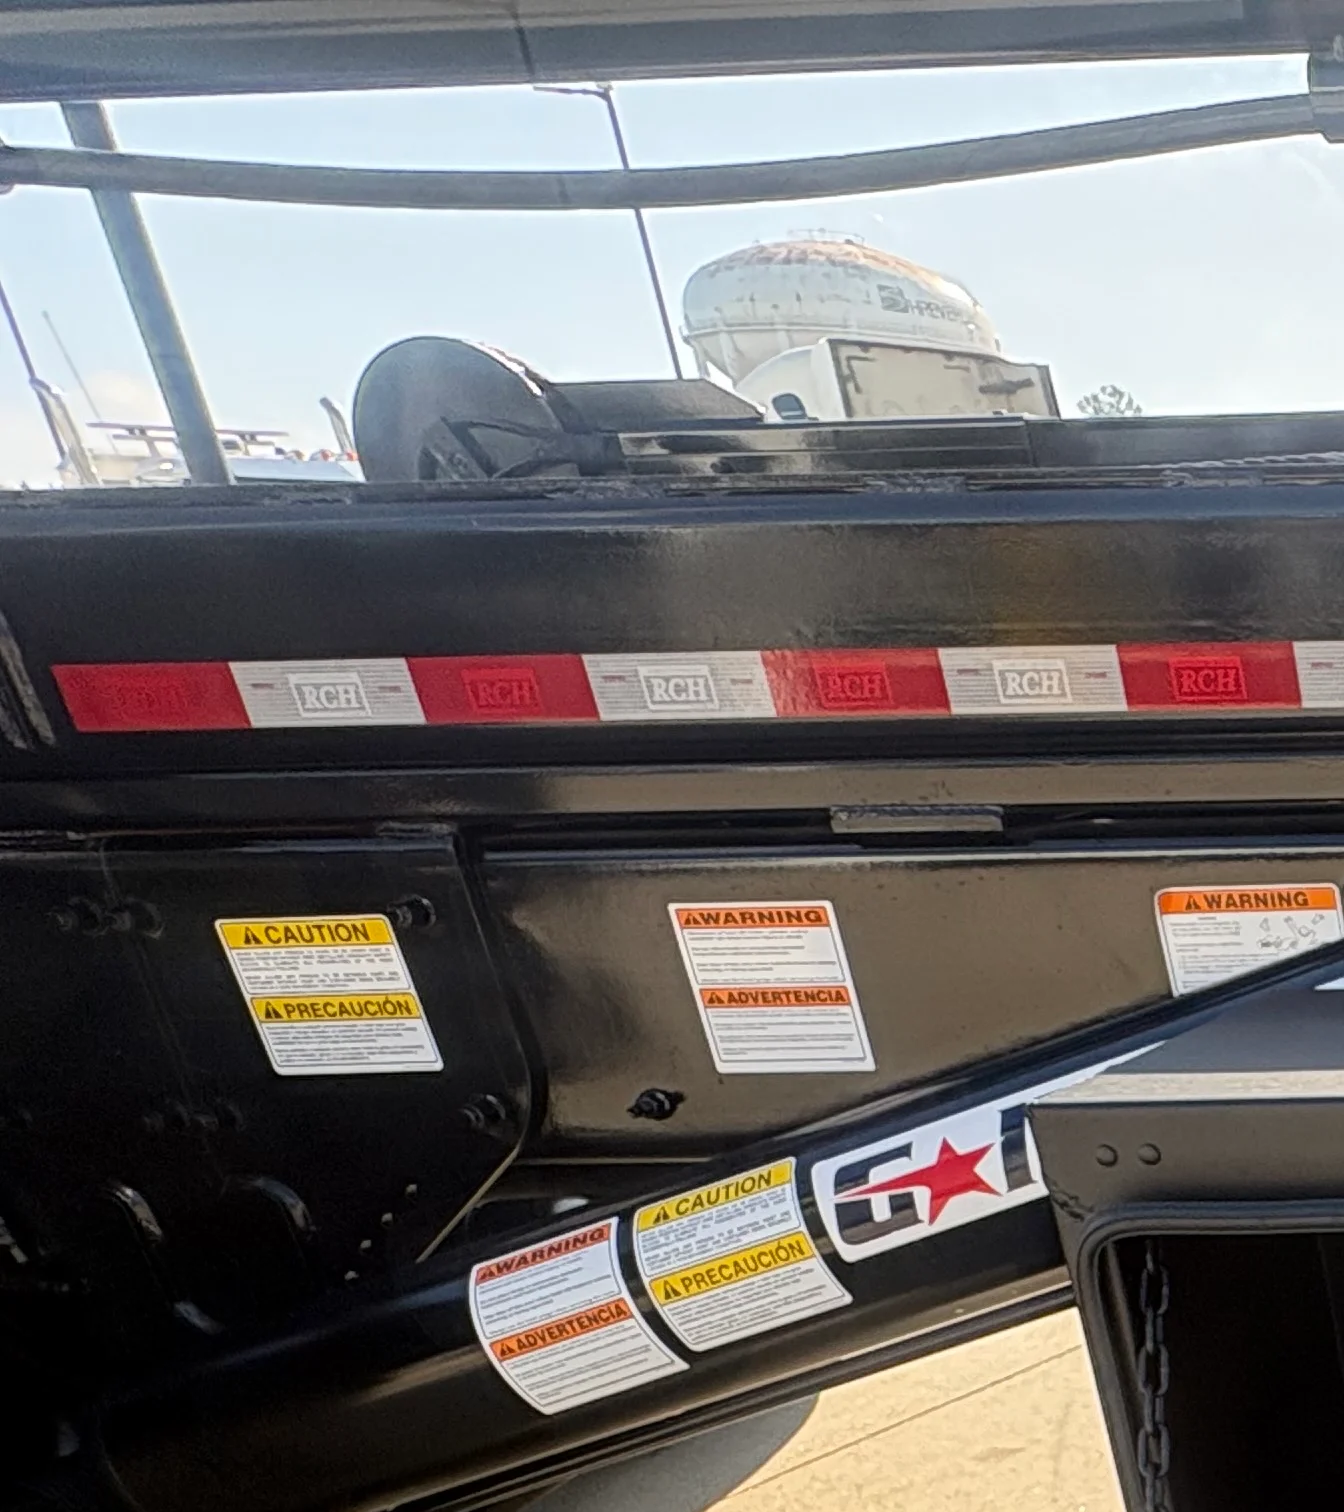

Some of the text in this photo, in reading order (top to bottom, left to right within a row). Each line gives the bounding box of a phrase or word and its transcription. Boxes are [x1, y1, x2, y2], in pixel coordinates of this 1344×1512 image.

[301, 684, 360, 709] RCH
[478, 679, 533, 706] RCH
[652, 677, 708, 702] RCH
[826, 671, 883, 699] RCH
[1004, 670, 1060, 696] RCH
[1180, 668, 1237, 693] RCH
[1203, 892, 1310, 909] WARNING
[264, 923, 371, 945] CAUTION
[699, 911, 823, 925] WARNING
[283, 996, 412, 1019] PRECAUCIÓN
[726, 990, 846, 1005] ADVERTENCIA
[675, 1169, 772, 1217] CAUTION
[495, 1228, 604, 1271] WARNING
[680, 1240, 806, 1294] PRECAUCIÓN
[515, 1305, 628, 1350] ADVERTENCIA
